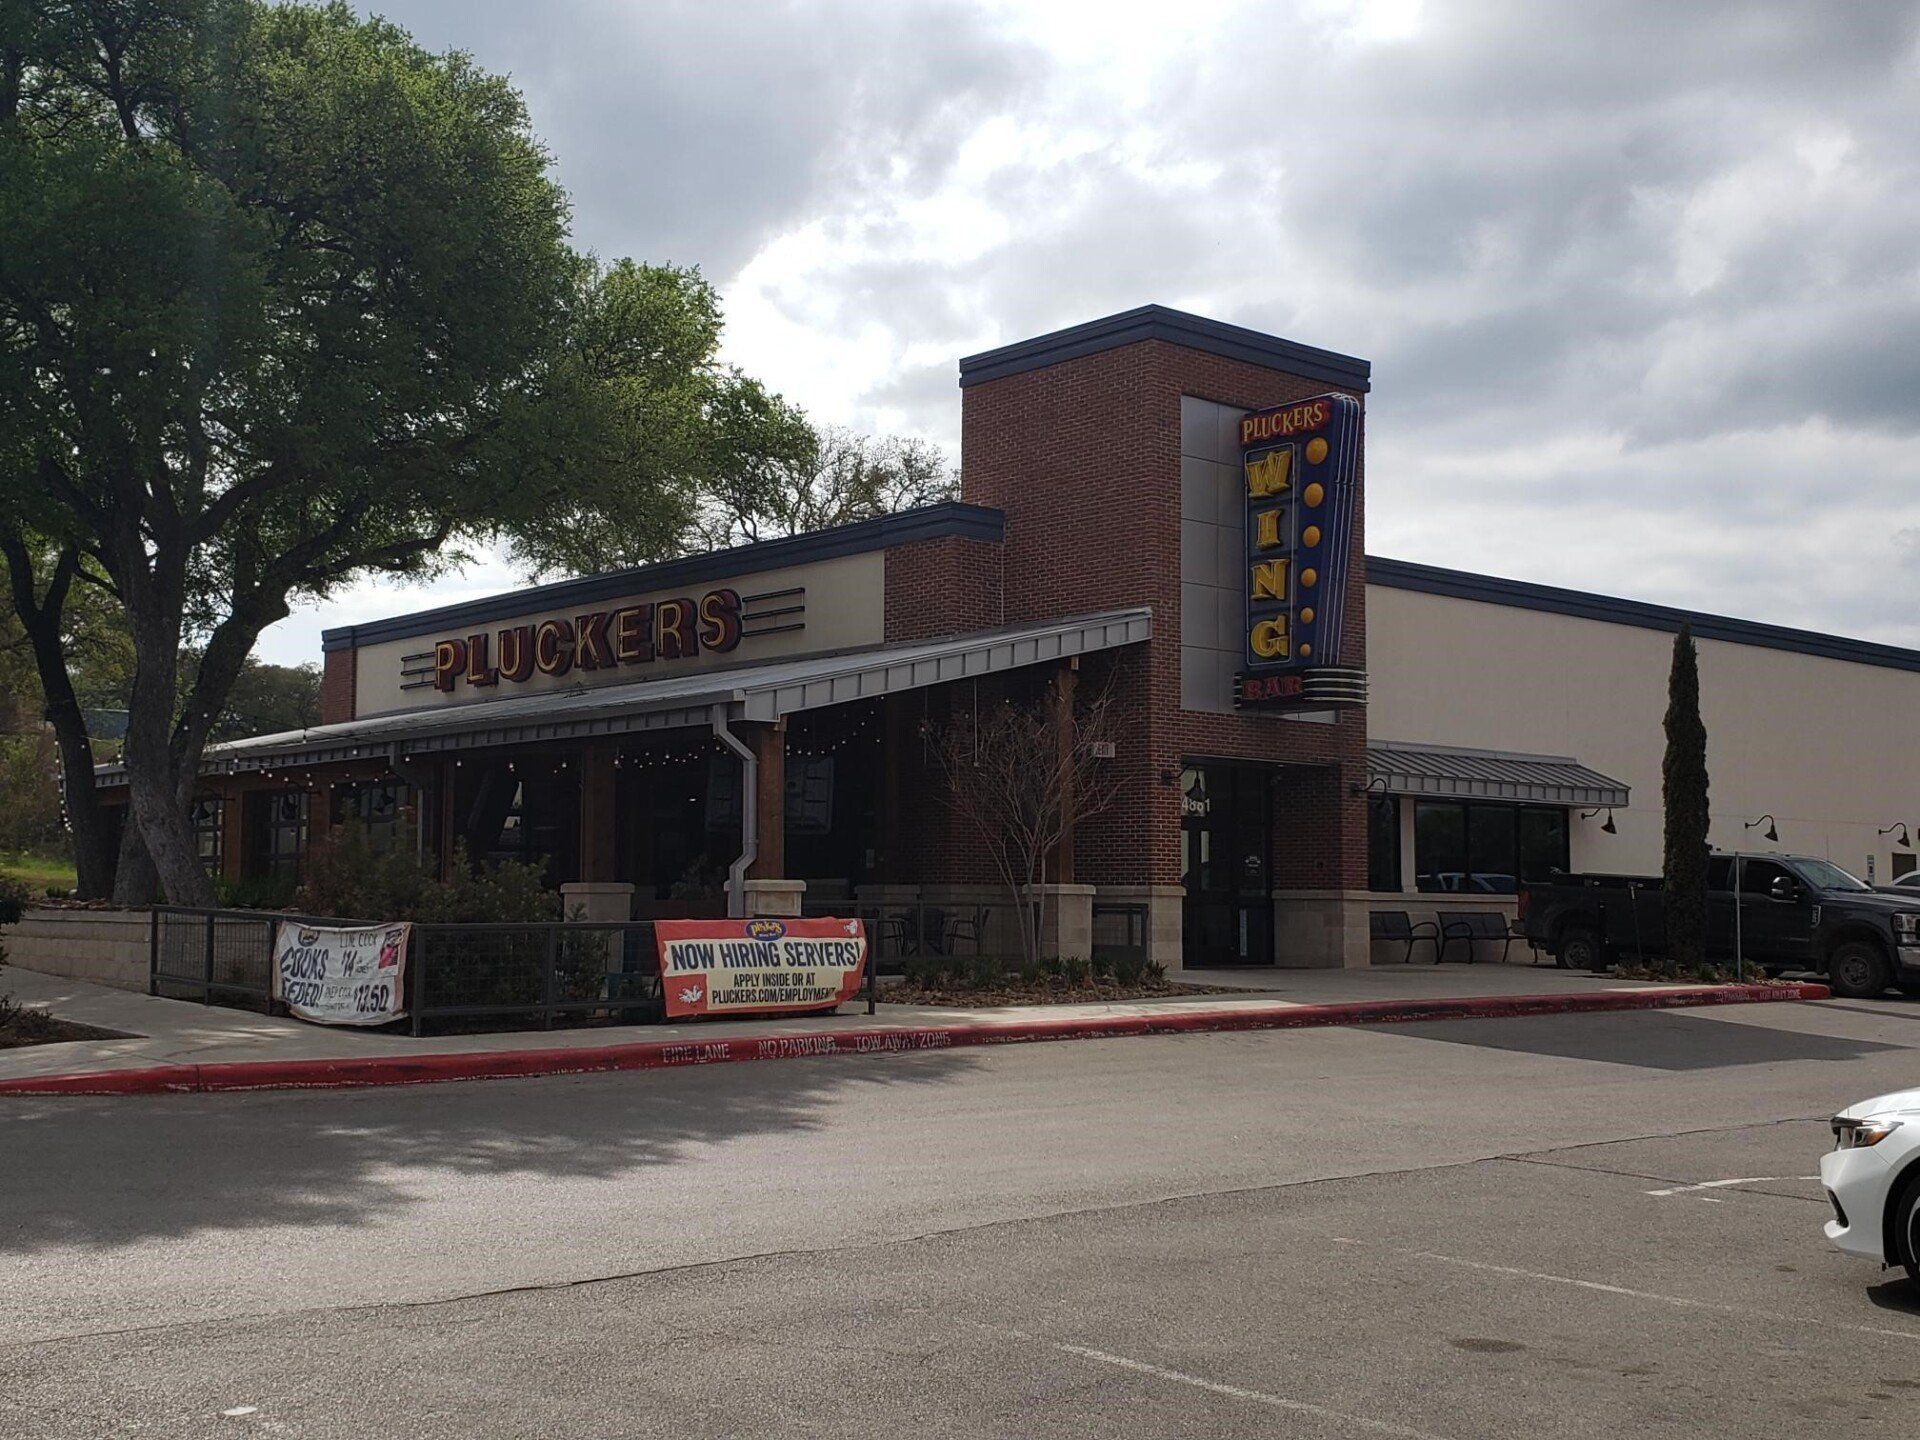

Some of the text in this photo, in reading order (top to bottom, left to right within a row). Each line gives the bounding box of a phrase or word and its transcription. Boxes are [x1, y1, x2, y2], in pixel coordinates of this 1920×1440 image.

[1242, 402, 1324, 442] PLUCKERS
[1245, 449, 1292, 660] WING
[434, 588, 742, 692] PLUCKERS
[1242, 675, 1303, 701] BAR
[281, 946, 329, 980] COOKS
[671, 941, 861, 971] NOW HIRING SERVERS!
[733, 972, 816, 988] APPLY INSIDE OR AT
[712, 987, 837, 1004] PLUCKERS.COM/EMPLOYMENT
[695, 1043, 730, 1061] LANE
[758, 1040, 777, 1055] NO
[779, 1036, 836, 1056] PARKING
[854, 1035, 882, 1052] TOW
[919, 1031, 952, 1048] ZONE
